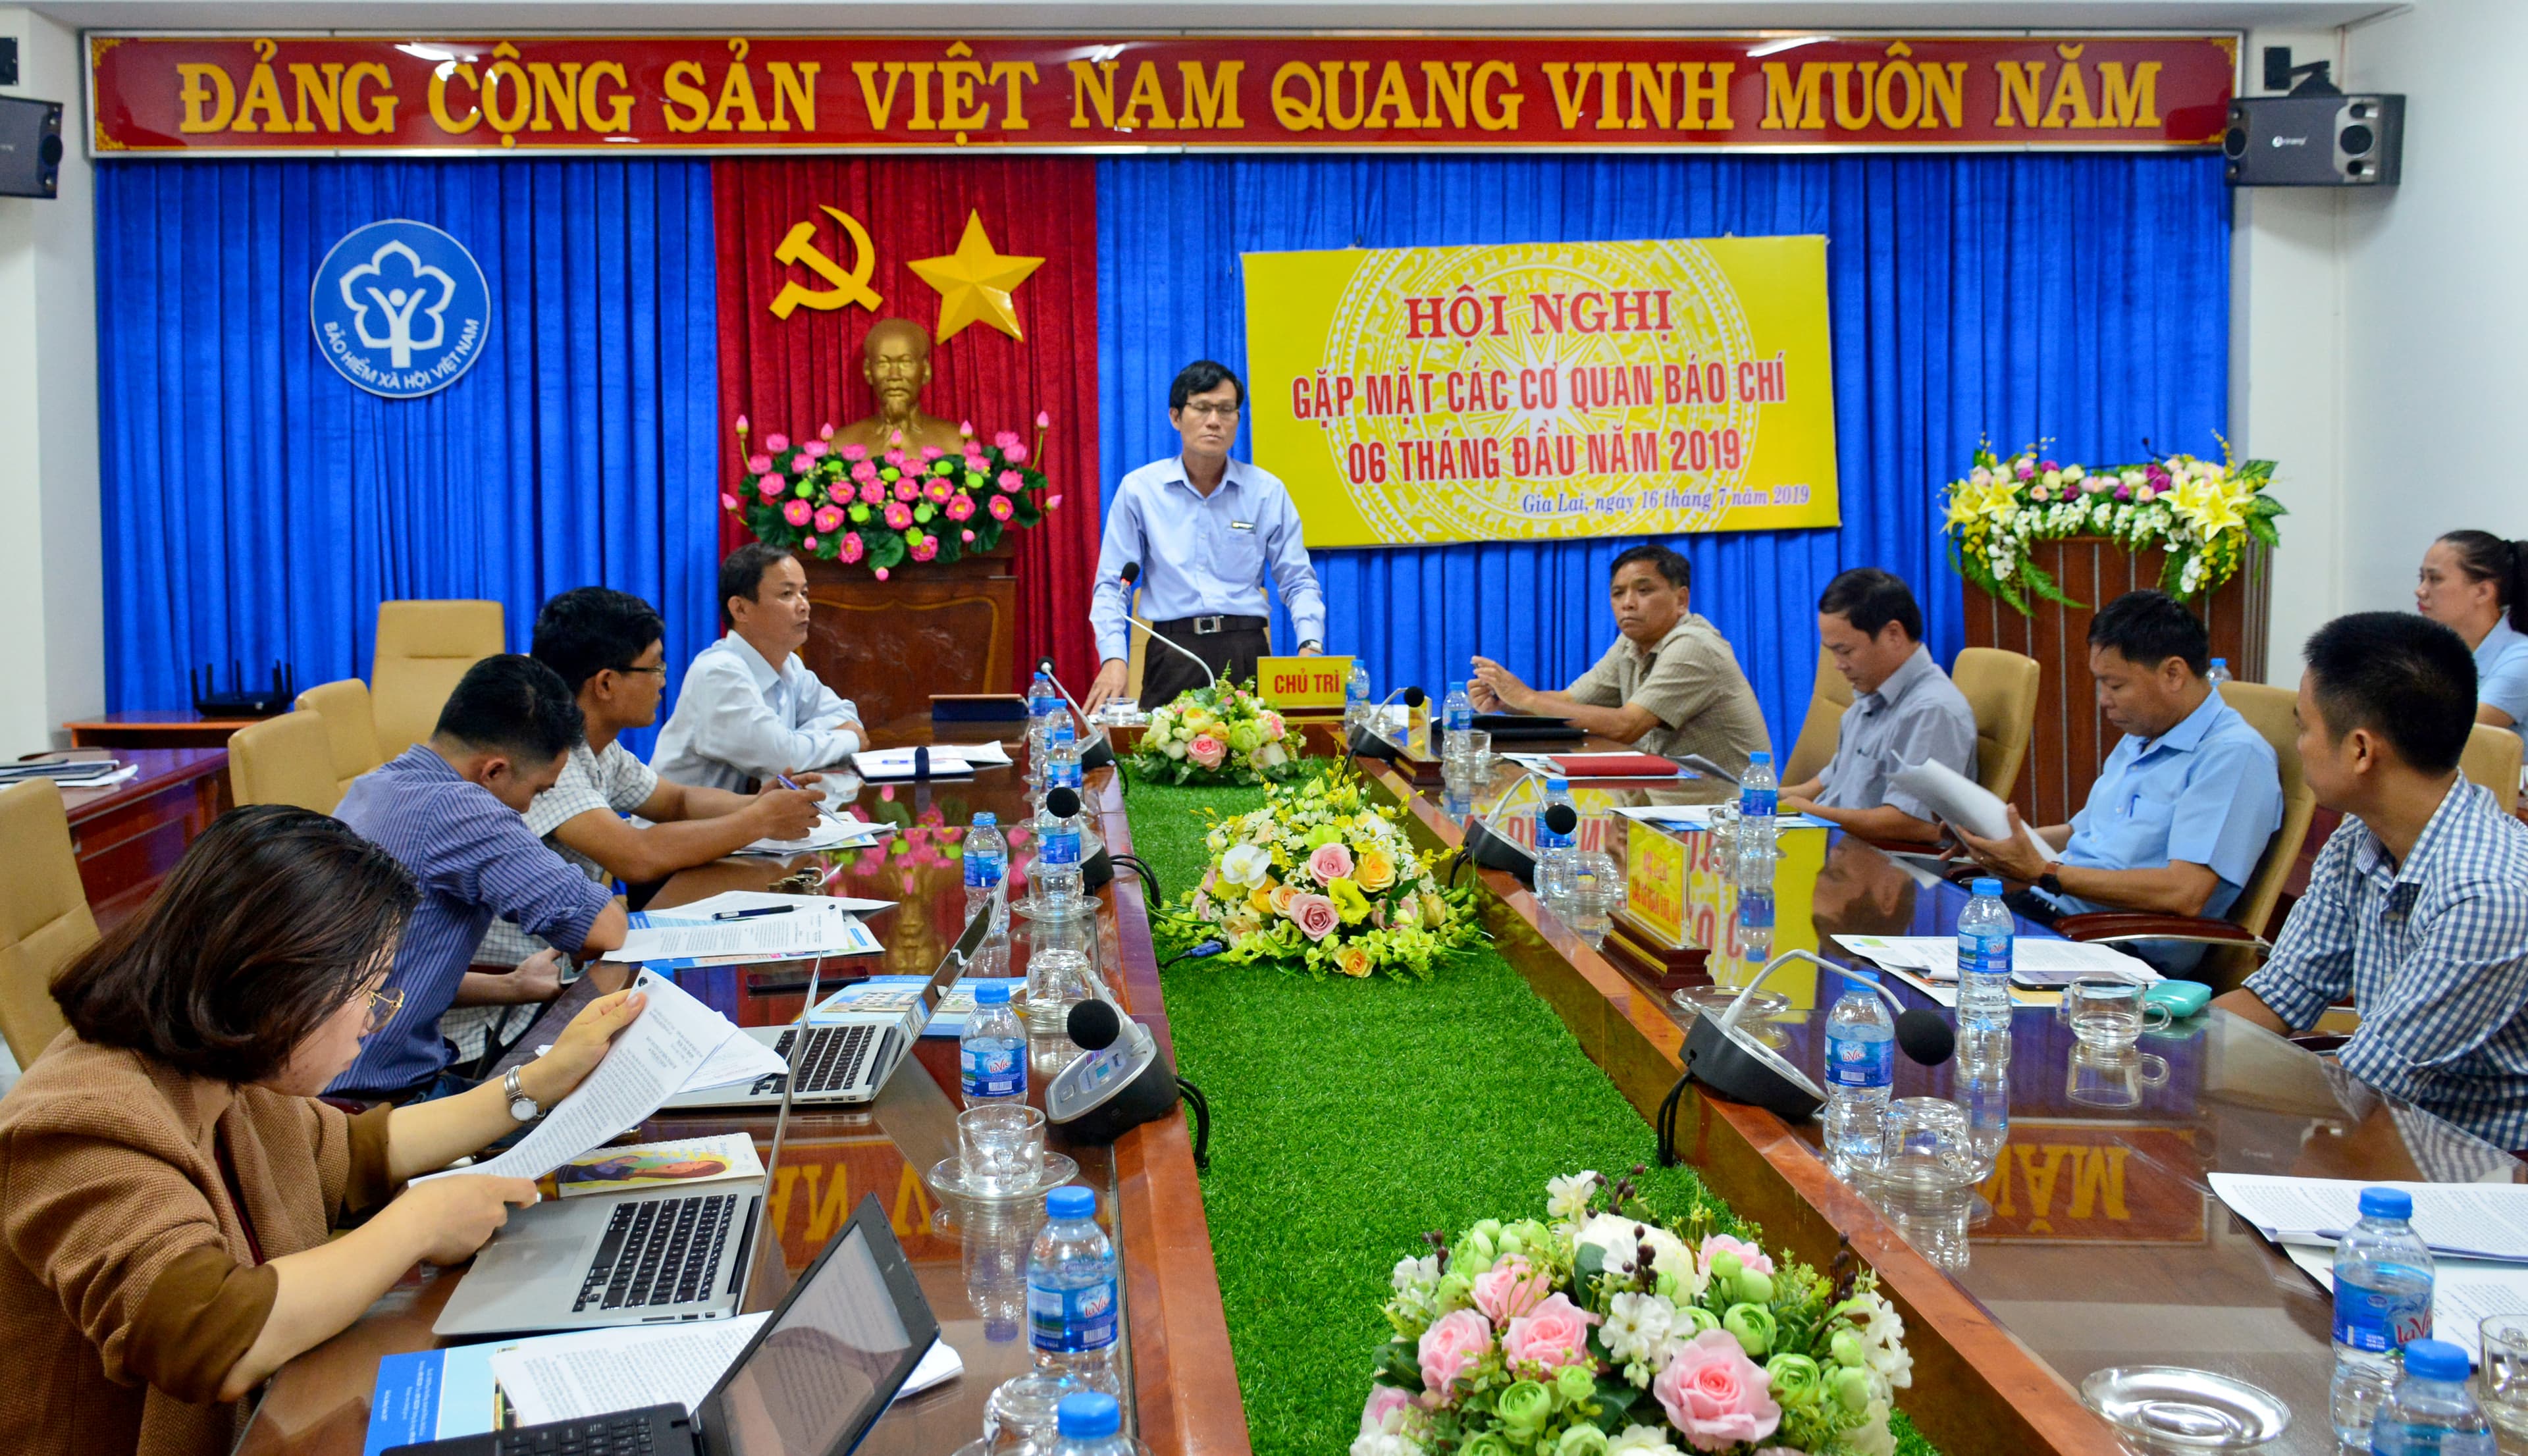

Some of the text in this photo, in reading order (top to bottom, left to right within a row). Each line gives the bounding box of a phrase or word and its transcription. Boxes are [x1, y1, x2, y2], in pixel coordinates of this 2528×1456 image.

[176, 37, 2163, 149] ĐẢNG CỘNG SẢN VIỆT NAM QUANG VINH MUÔN NĂM
[1404, 283, 1674, 348] HỘI NGHỊ
[324, 321, 347, 353] BẢO
[403, 370, 432, 390] HỘI
[431, 351, 461, 379] VIỆT
[455, 319, 479, 355] NAM
[1292, 351, 1786, 429] GẶP MẶT CÁC CƠ QUAN BÁO CHÍ
[1348, 419, 1740, 485] 06 THÁNG ĐẦU NĂM 2019
[1523, 484, 1810, 515] Gia Lai, ngày 16 tháng 7 năm 2019
[1274, 667, 1340, 694] CHỦ TRÌ
